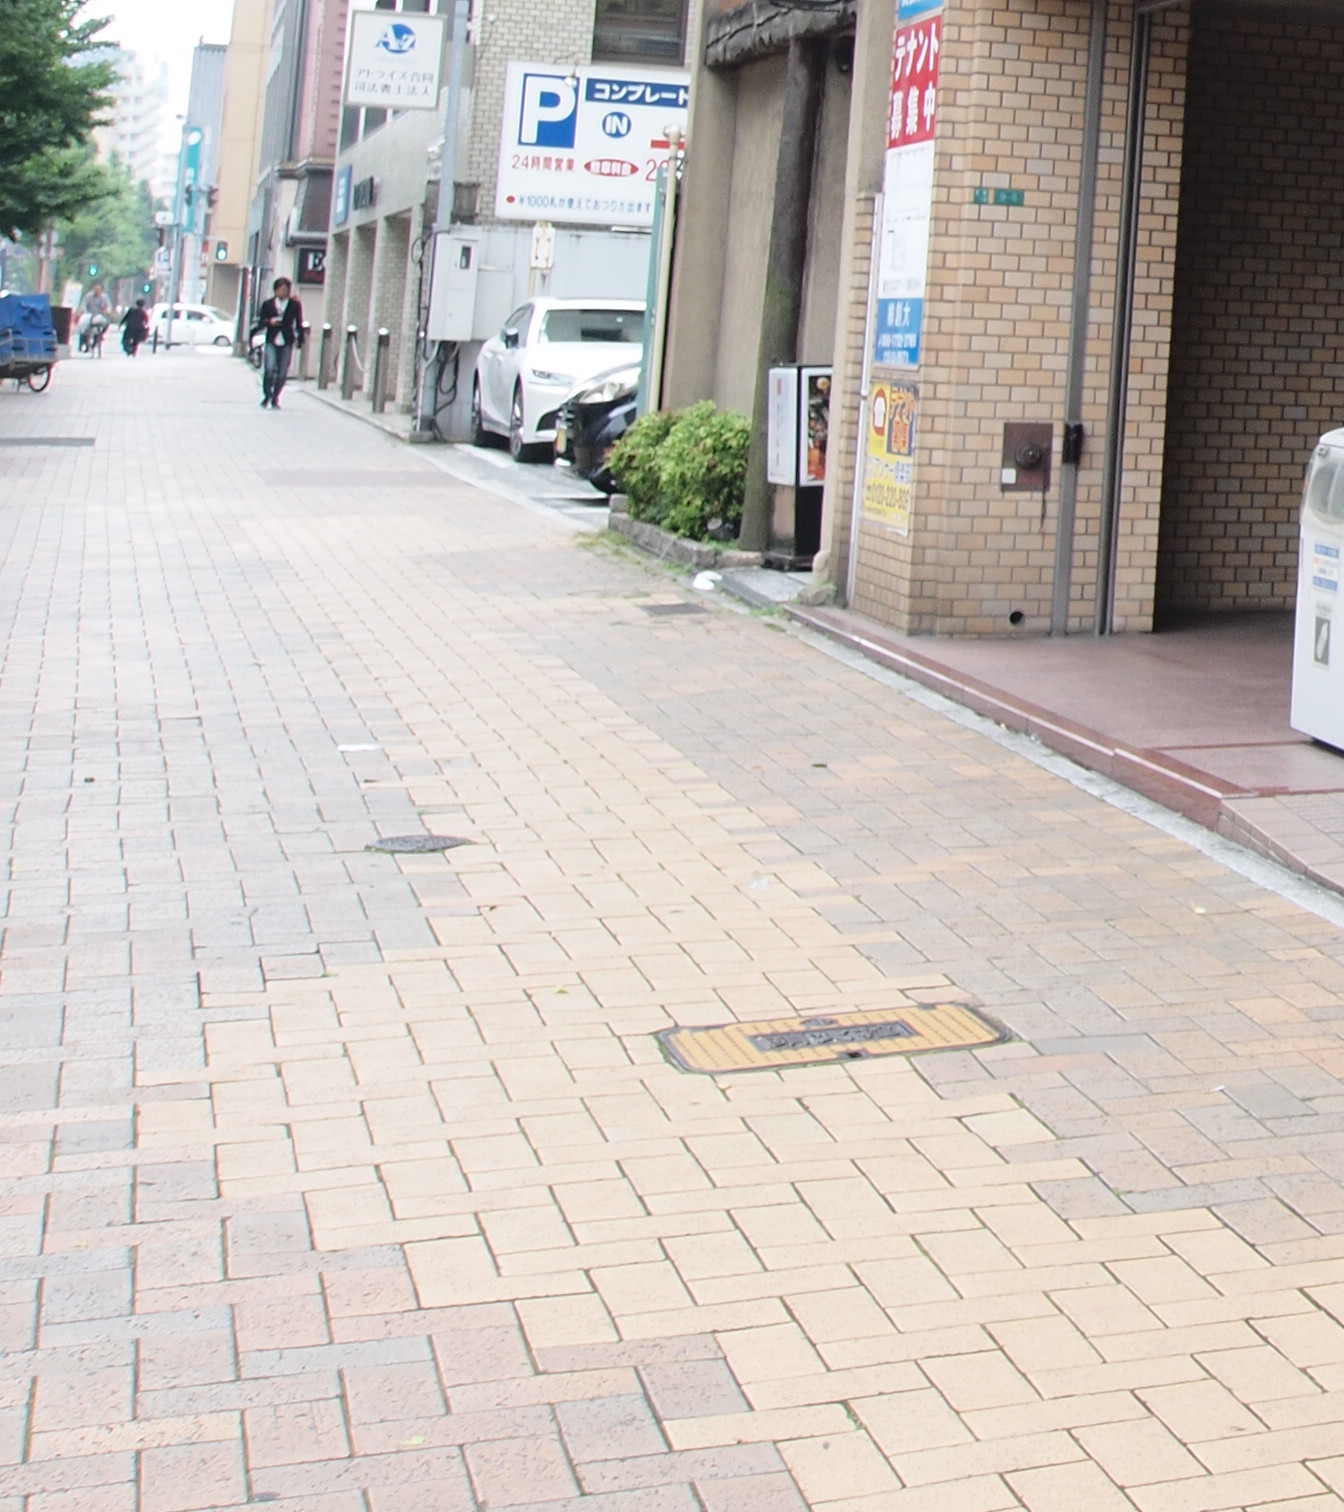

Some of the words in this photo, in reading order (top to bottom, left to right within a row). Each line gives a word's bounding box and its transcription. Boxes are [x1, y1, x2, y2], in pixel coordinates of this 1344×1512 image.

[894, 22, 939, 82] テナント
[520, 75, 577, 145] P
[604, 115, 629, 136] IN
[511, 154, 576, 173] 24時間営業
